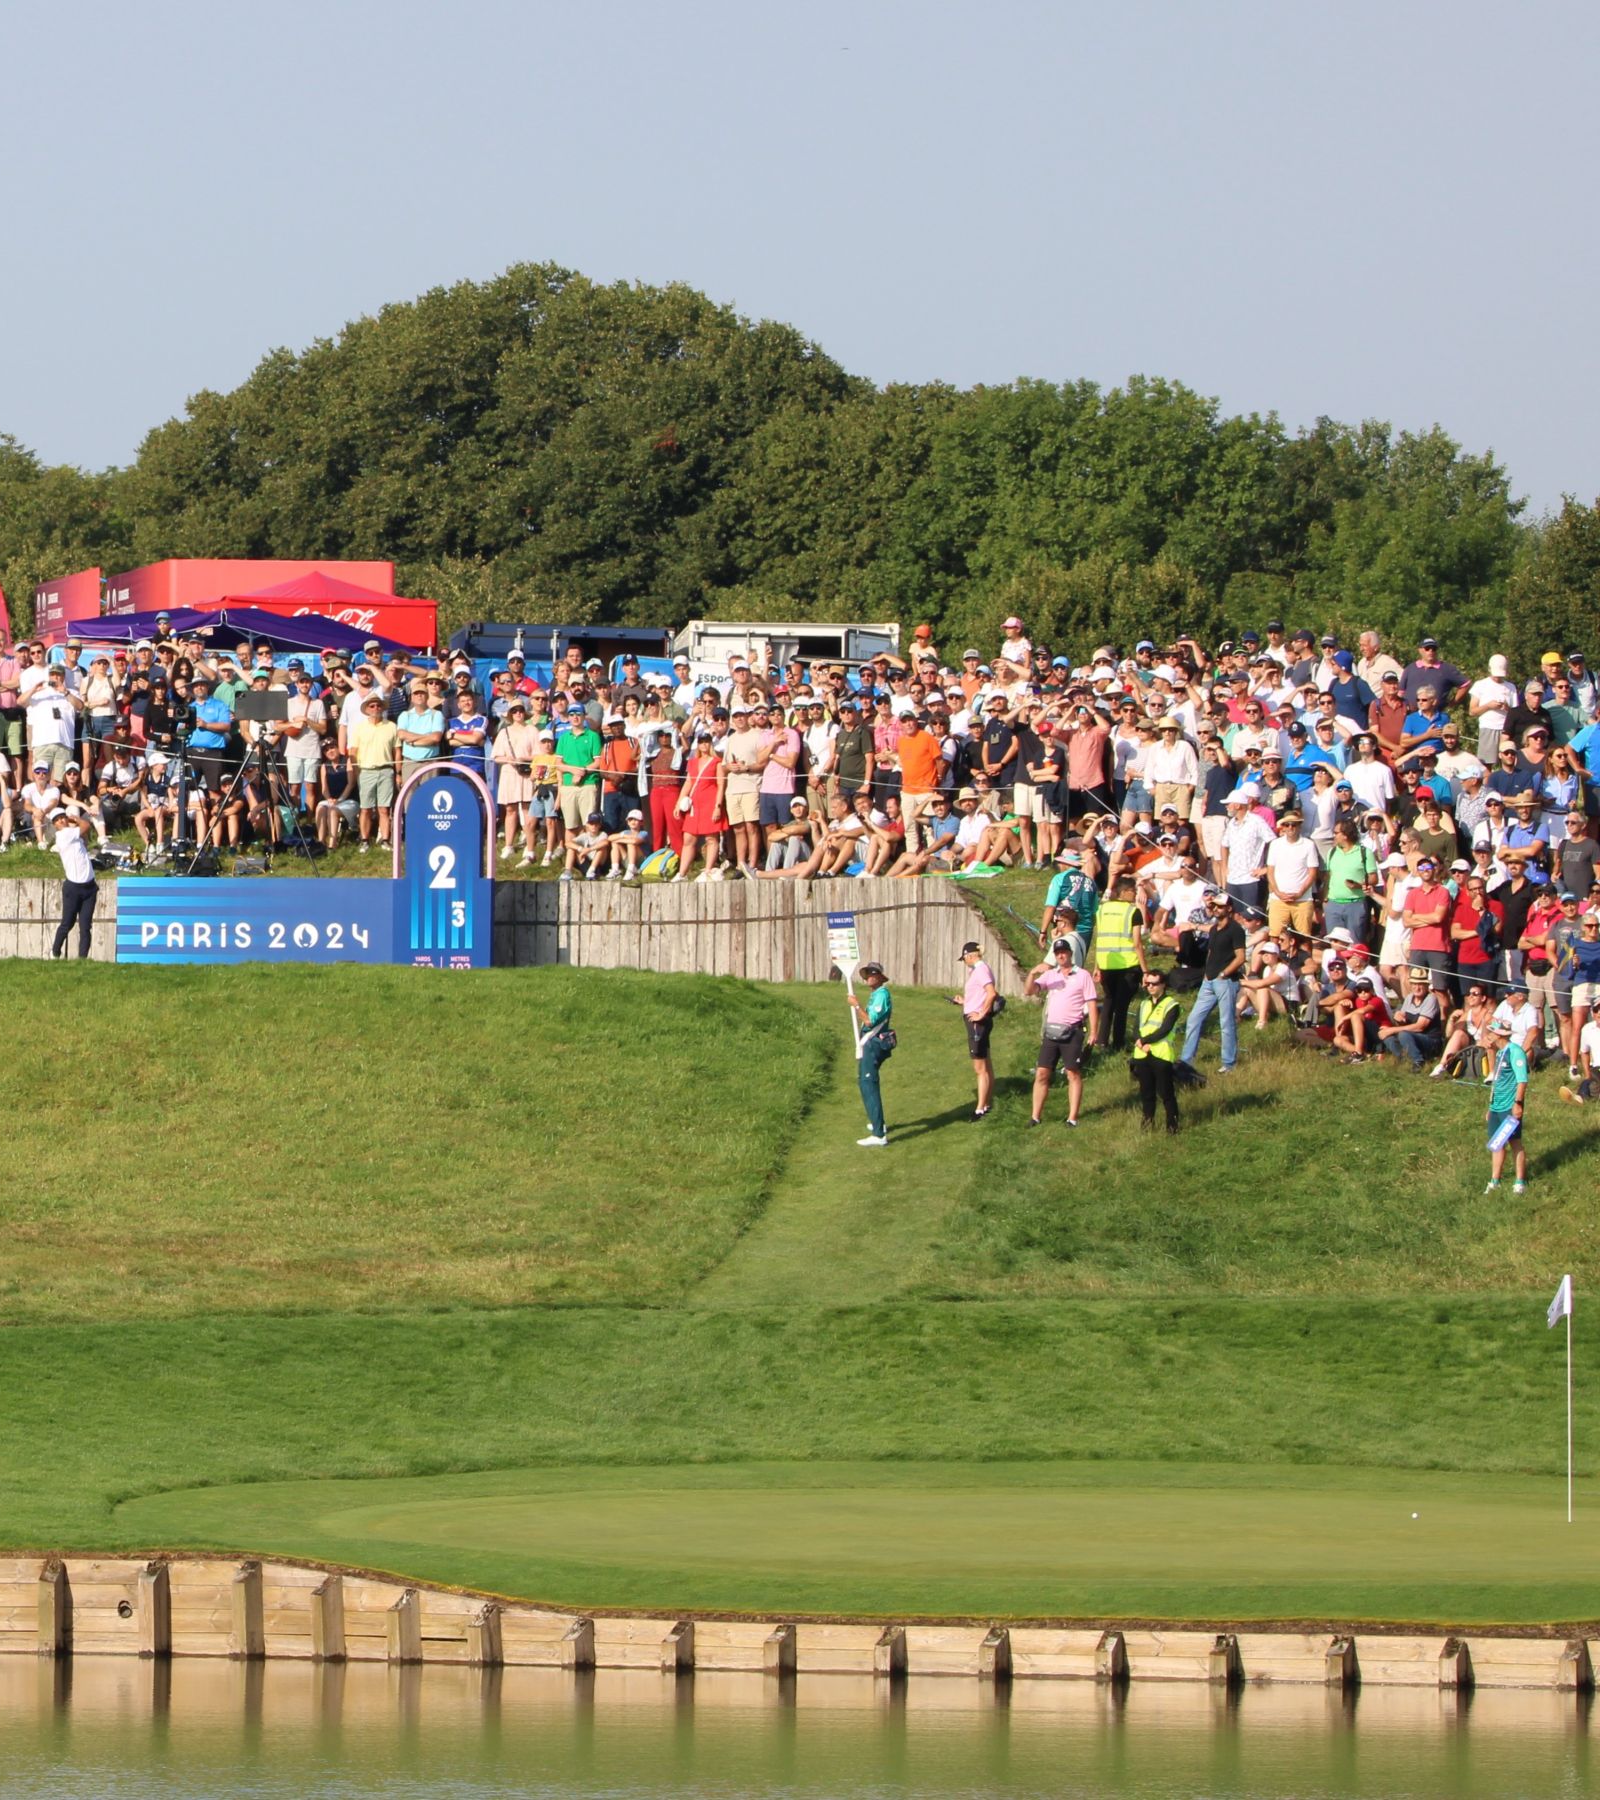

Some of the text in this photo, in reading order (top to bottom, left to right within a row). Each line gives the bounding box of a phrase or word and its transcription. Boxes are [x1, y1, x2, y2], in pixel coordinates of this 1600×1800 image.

[428, 845, 456, 889] 2
[451, 908, 465, 928] 3
[141, 922, 368, 949] PARIS 2024
